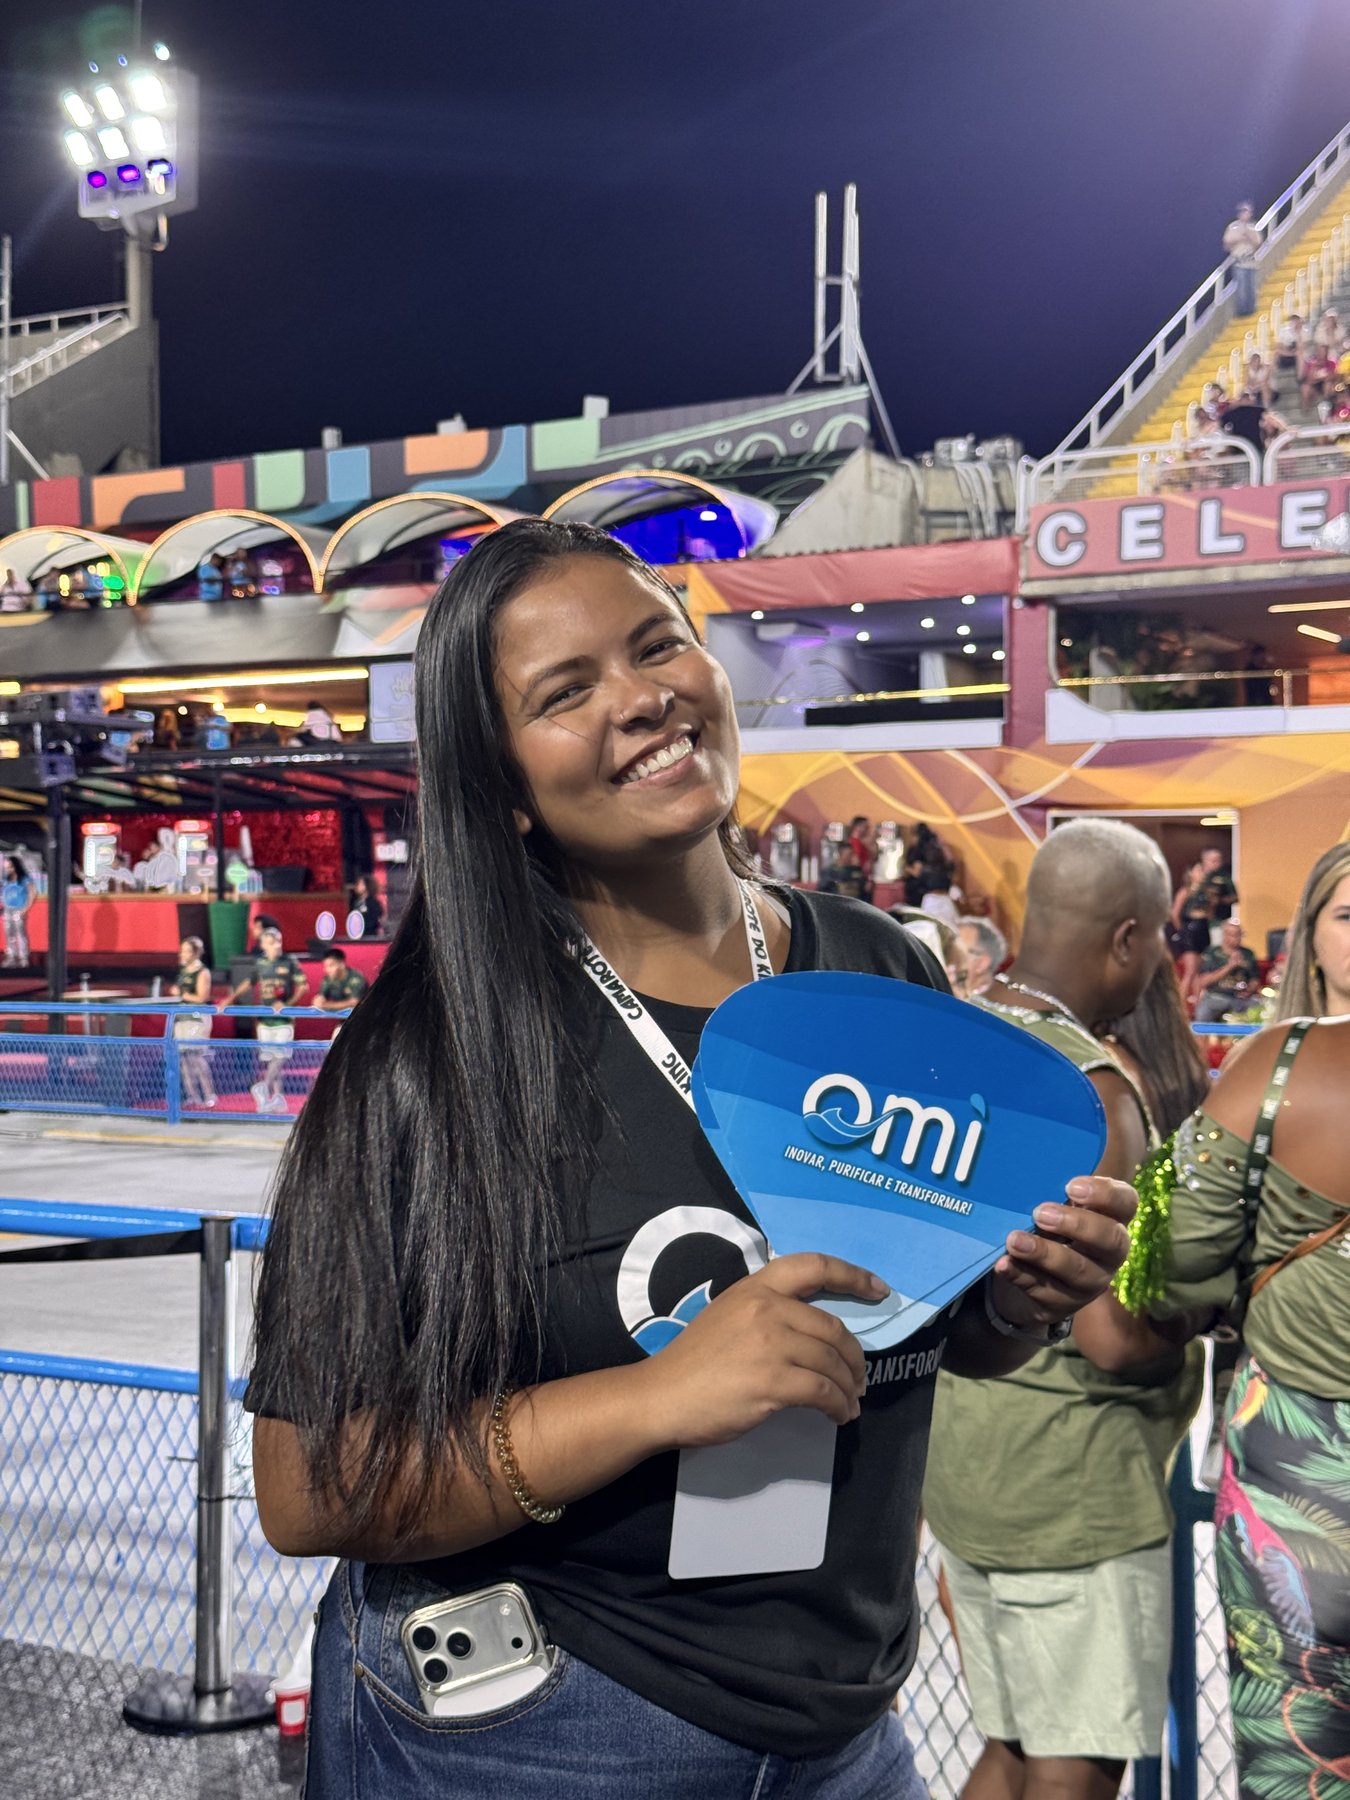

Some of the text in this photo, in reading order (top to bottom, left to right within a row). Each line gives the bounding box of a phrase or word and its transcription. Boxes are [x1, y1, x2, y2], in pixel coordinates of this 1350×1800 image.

[1037, 489, 1350, 567] CELE
[752, 937, 767, 960] DO
[784, 1145, 973, 1215] INOVAR, PURIFICAR E TRANSFORMAR!
